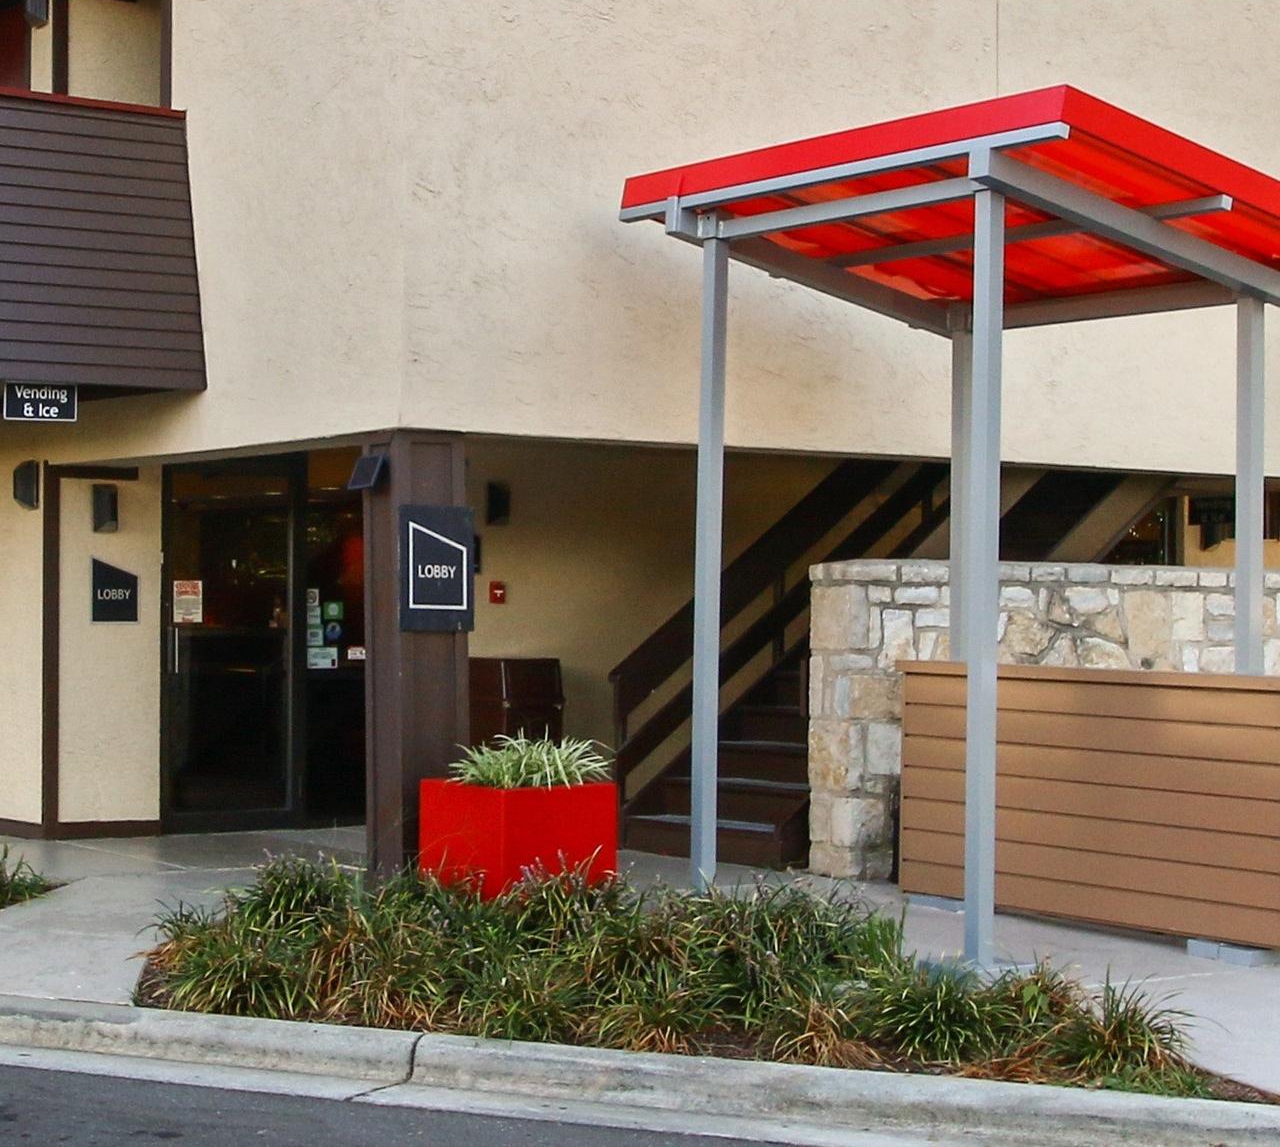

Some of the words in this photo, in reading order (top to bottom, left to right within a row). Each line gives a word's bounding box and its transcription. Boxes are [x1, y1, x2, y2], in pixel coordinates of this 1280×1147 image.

[15, 385, 68, 403] Vending
[23, 402, 34, 417] &
[38, 403, 59, 418] Ice
[417, 564, 456, 579] LOBBY
[97, 588, 131, 600] LOBBY
